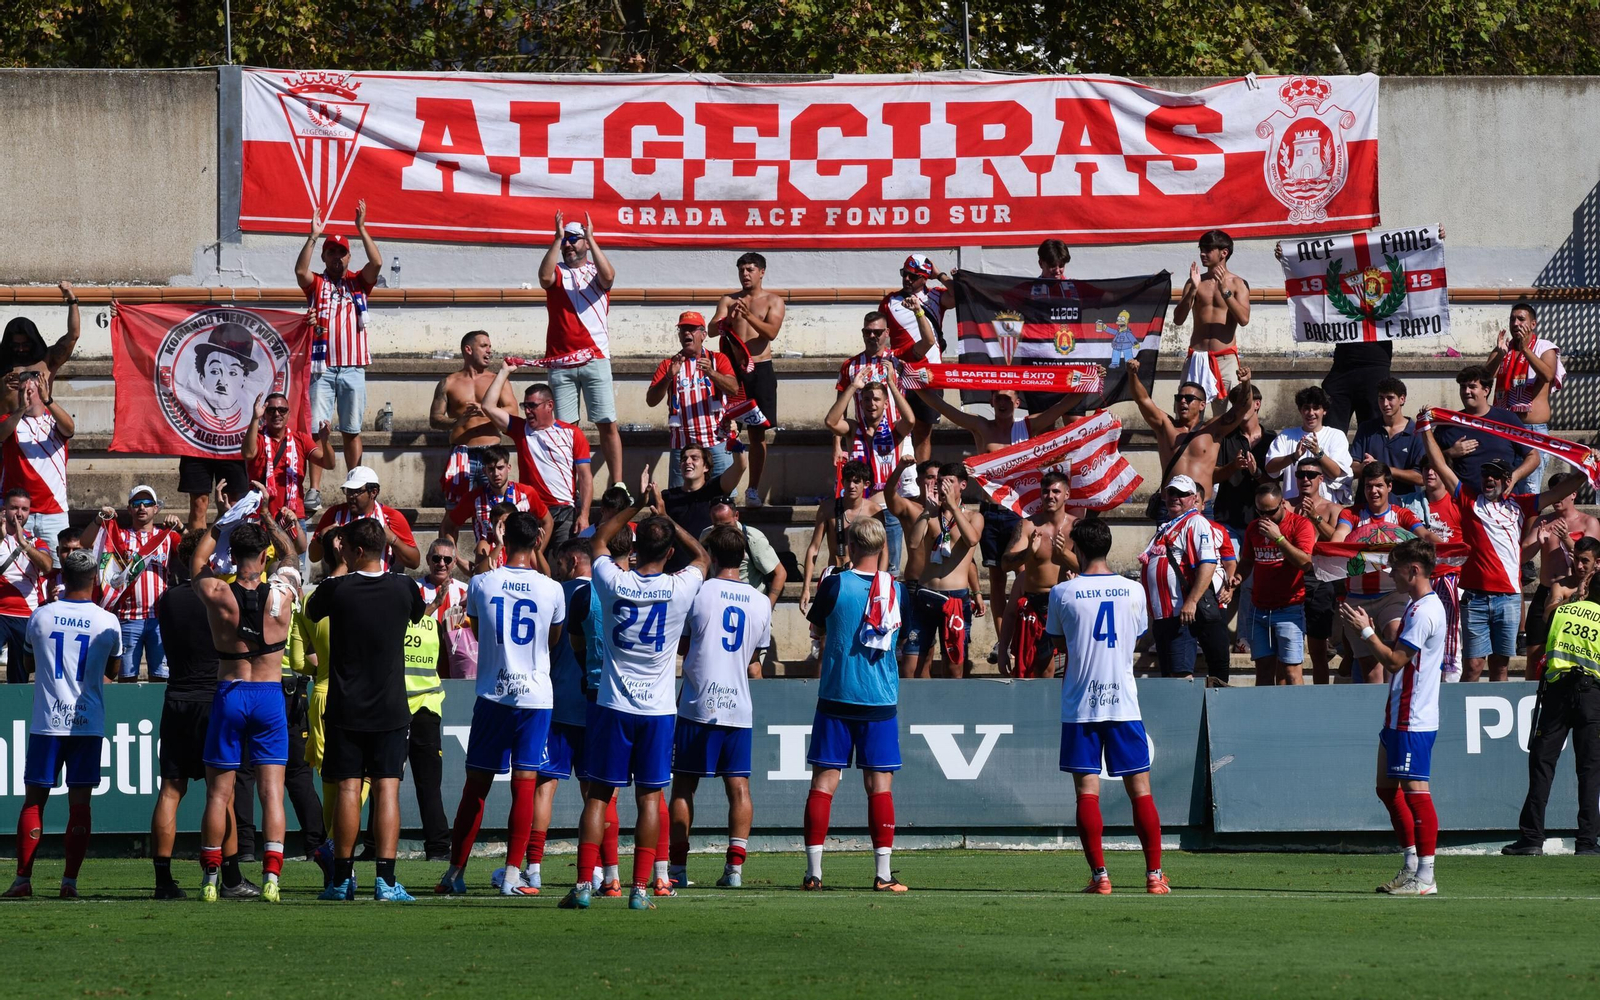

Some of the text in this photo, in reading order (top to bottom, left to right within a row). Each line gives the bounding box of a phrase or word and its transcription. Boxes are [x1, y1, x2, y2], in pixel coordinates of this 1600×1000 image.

[301, 128, 337, 137] ALGECIRAS
[402, 97, 1224, 200] ALGECIRAS
[617, 204, 1011, 226] GRADA ACF FONDO SUR
[1297, 228, 1431, 263] ACF FANS
[1300, 273, 1432, 292] 19 12
[96, 312, 109, 329] 6
[1050, 307, 1079, 320] 11205
[165, 312, 285, 360] KOMANDO FUENTE NUEVA
[1303, 314, 1442, 342] BARRIO C.RAYO
[945, 369, 1055, 379] SÉ PARTE DEL ÉXITO
[194, 428, 246, 447] ALGECIRAS
[1450, 415, 1572, 451] ALGECIRAS CF
[985, 454, 1030, 480] Algeciras
[1033, 439, 1059, 458] Club
[501, 579, 531, 592] ÁNGEL
[616, 584, 672, 599] ÓSCAR CASTRO
[1075, 588, 1130, 599] ALEIX COCH
[720, 590, 750, 603] MANIN
[53, 616, 91, 629] TOMÁS
[489, 596, 538, 646] 16
[1557, 605, 1600, 623] SEGURID
[612, 600, 668, 653] 24
[721, 605, 746, 653] 9
[1092, 601, 1118, 649] 4
[1562, 620, 1599, 642] 2383
[404, 634, 422, 648] 29
[48, 631, 91, 682] 11
[405, 654, 434, 664] SEGUR
